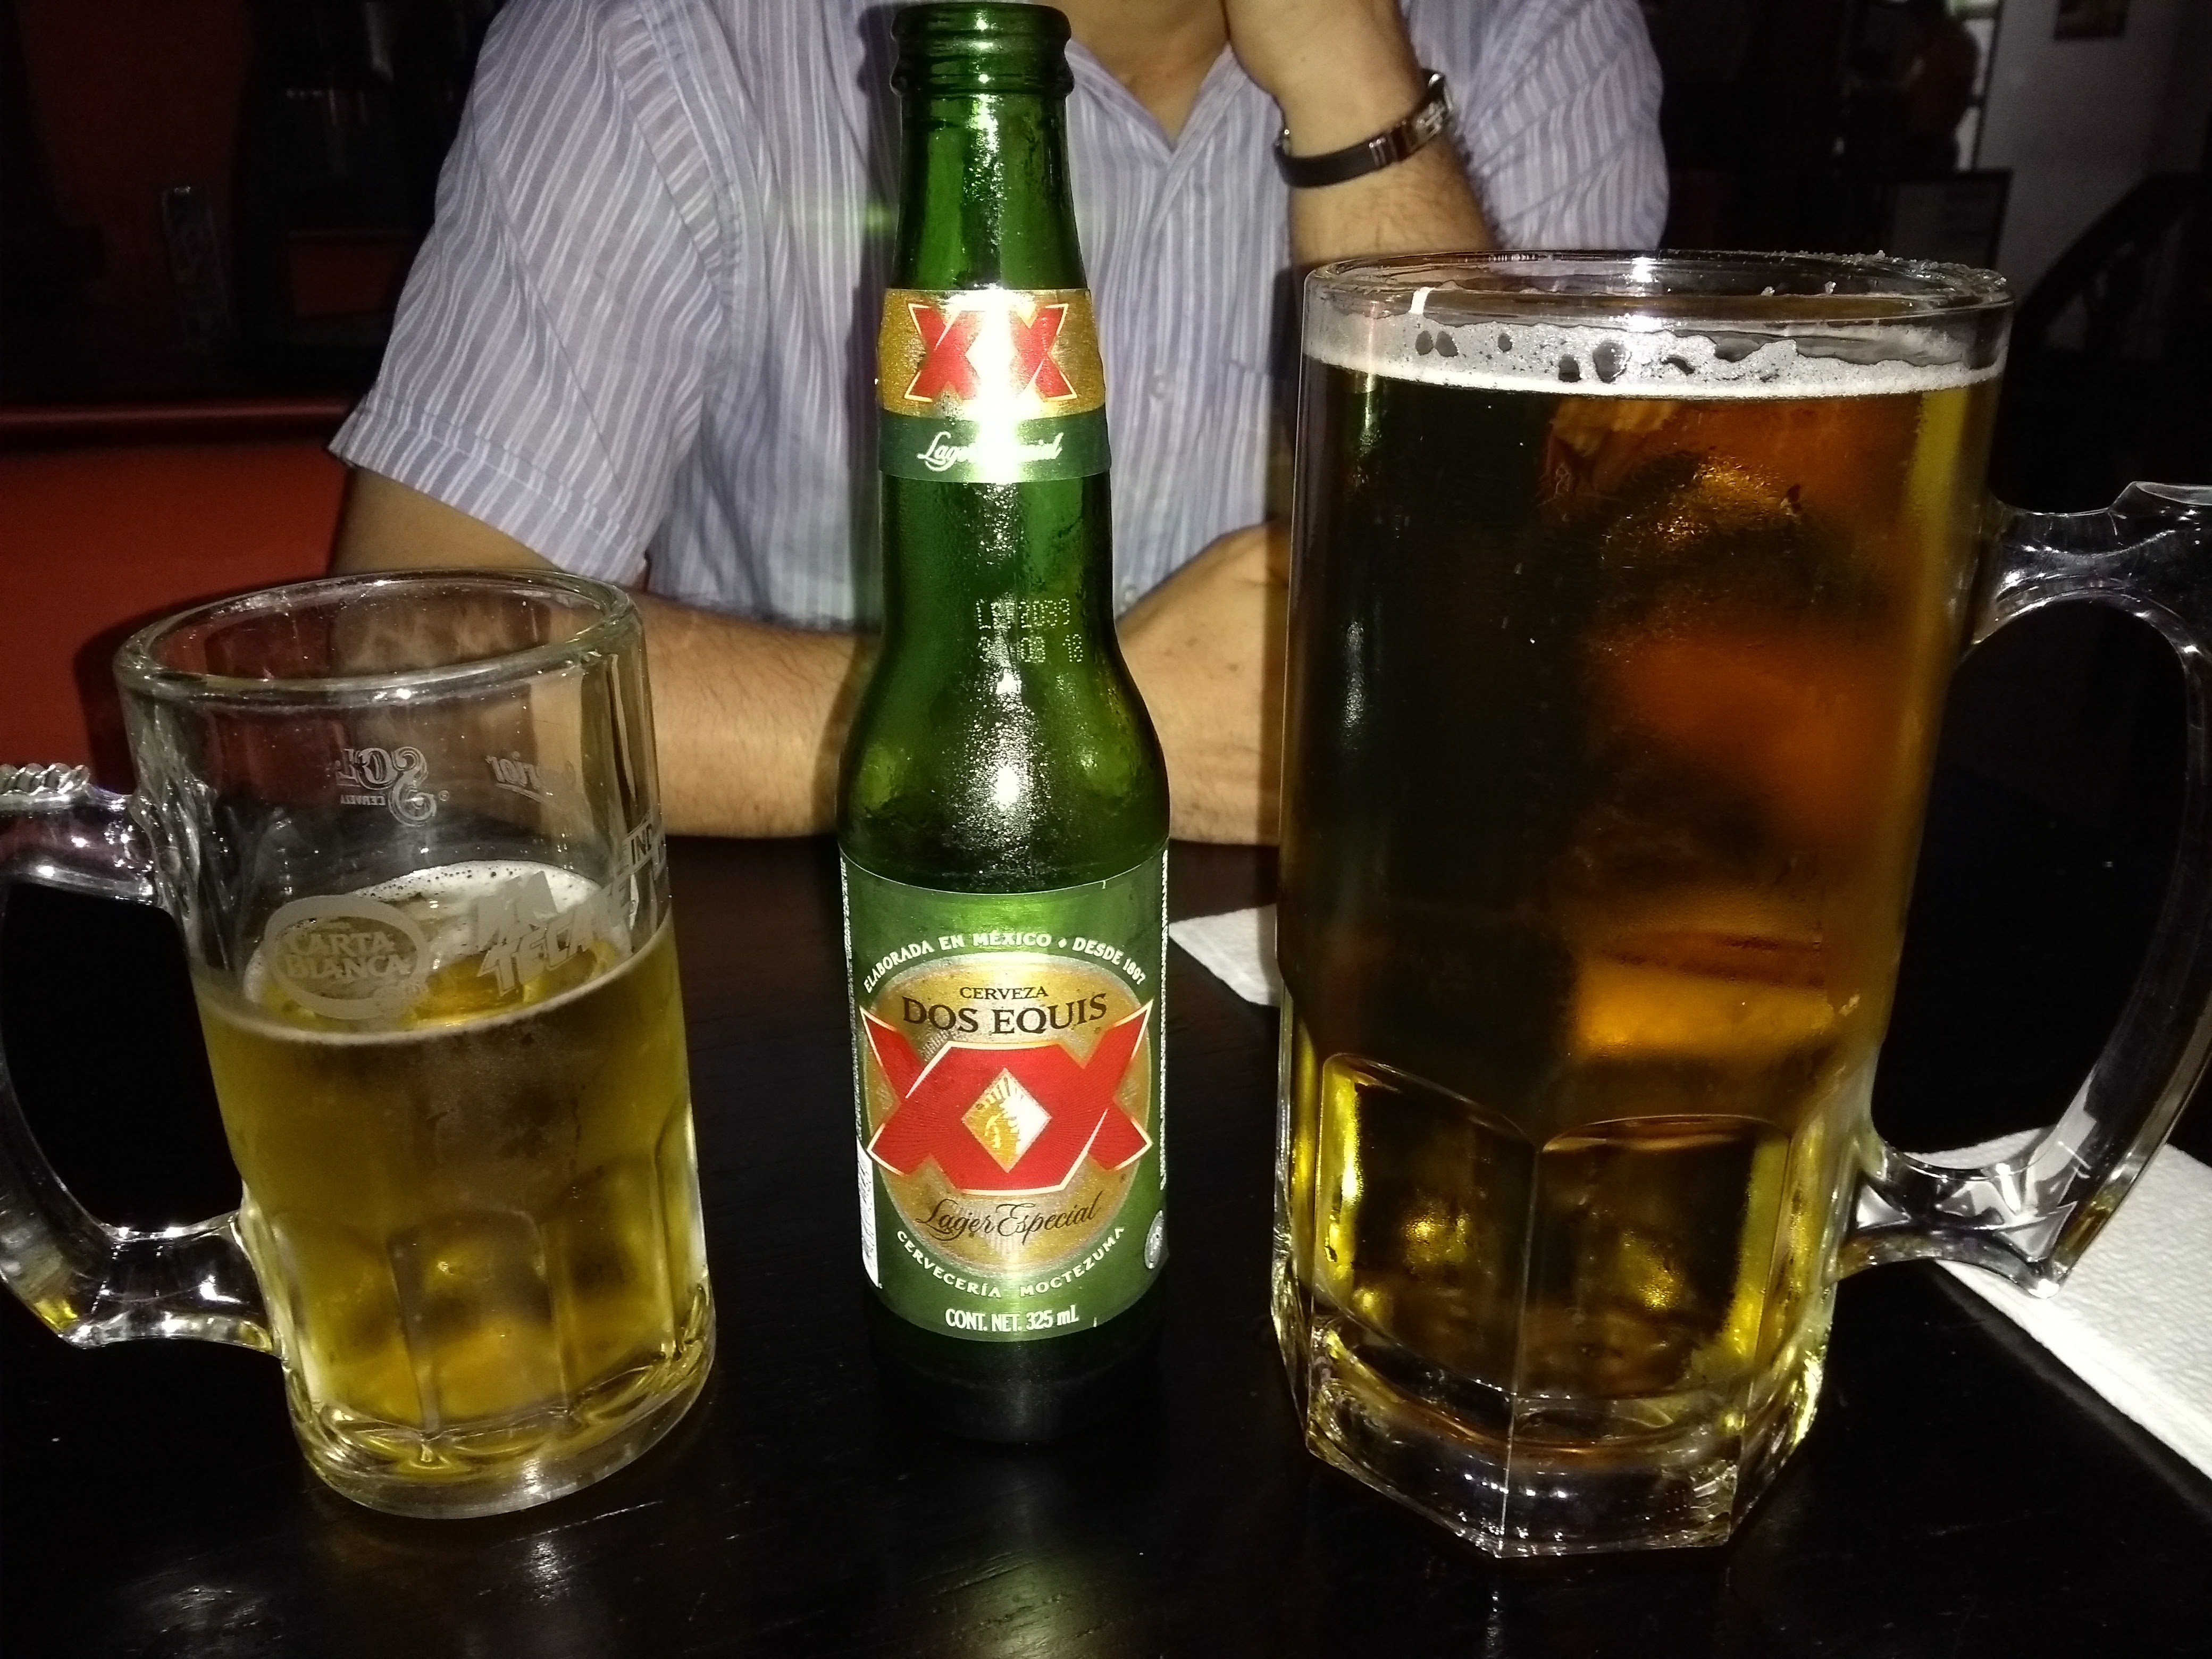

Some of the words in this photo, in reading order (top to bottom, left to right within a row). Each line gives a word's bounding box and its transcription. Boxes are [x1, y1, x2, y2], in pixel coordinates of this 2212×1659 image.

[282, 931, 395, 958] CARTA
[863, 940, 935, 993] ELABORADA
[939, 935, 965, 950] EN
[973, 929, 1052, 947] MÉXICO
[1071, 936, 1124, 964] DESDE
[1122, 957, 1147, 985] 1897
[283, 954, 411, 983] BLANCA
[959, 986, 1049, 1000] CERVEZA
[902, 995, 979, 1034] DOS
[992, 993, 1107, 1035] EQUIS
[916, 1198, 998, 1242] Lager
[994, 1190, 1103, 1245] Especial
[896, 1229, 1002, 1298] CERVECERÍA
[1019, 1227, 1125, 1297] MOCTEZUMA
[945, 1308, 988, 1331] CONT.
[991, 1311, 1023, 1332] NET.
[1026, 1310, 1053, 1328] 325
